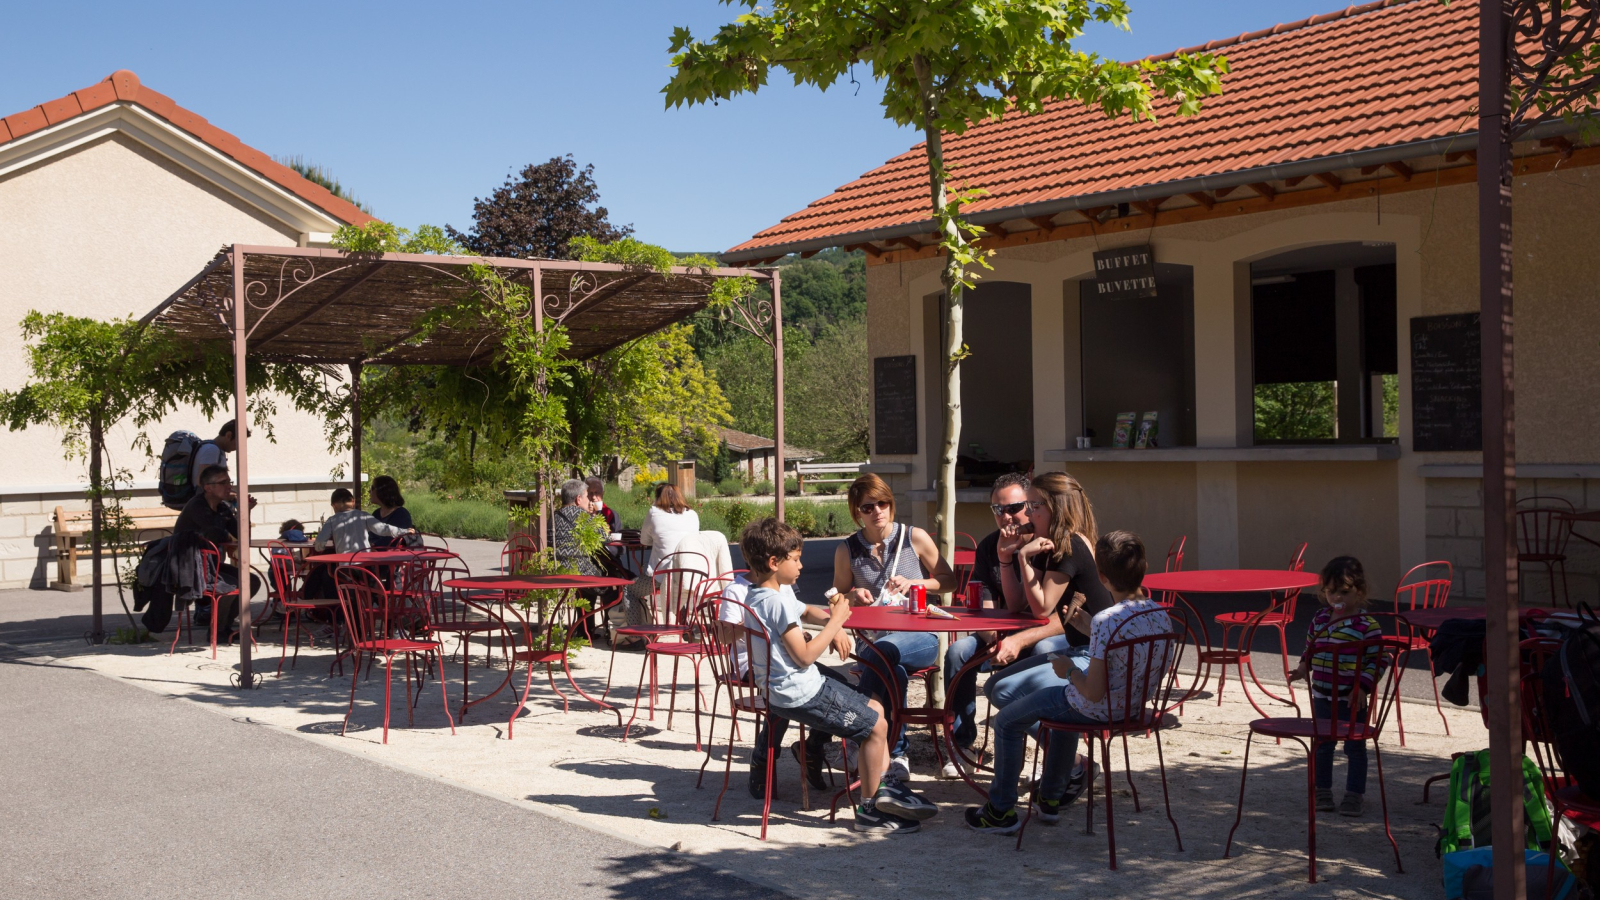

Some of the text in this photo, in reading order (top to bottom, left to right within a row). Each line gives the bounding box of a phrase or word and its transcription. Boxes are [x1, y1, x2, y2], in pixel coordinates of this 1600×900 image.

[1096, 253, 1149, 271] BUFFET
[1097, 276, 1156, 294] BUVETTE
[1427, 320, 1467, 332] BOISSONS
